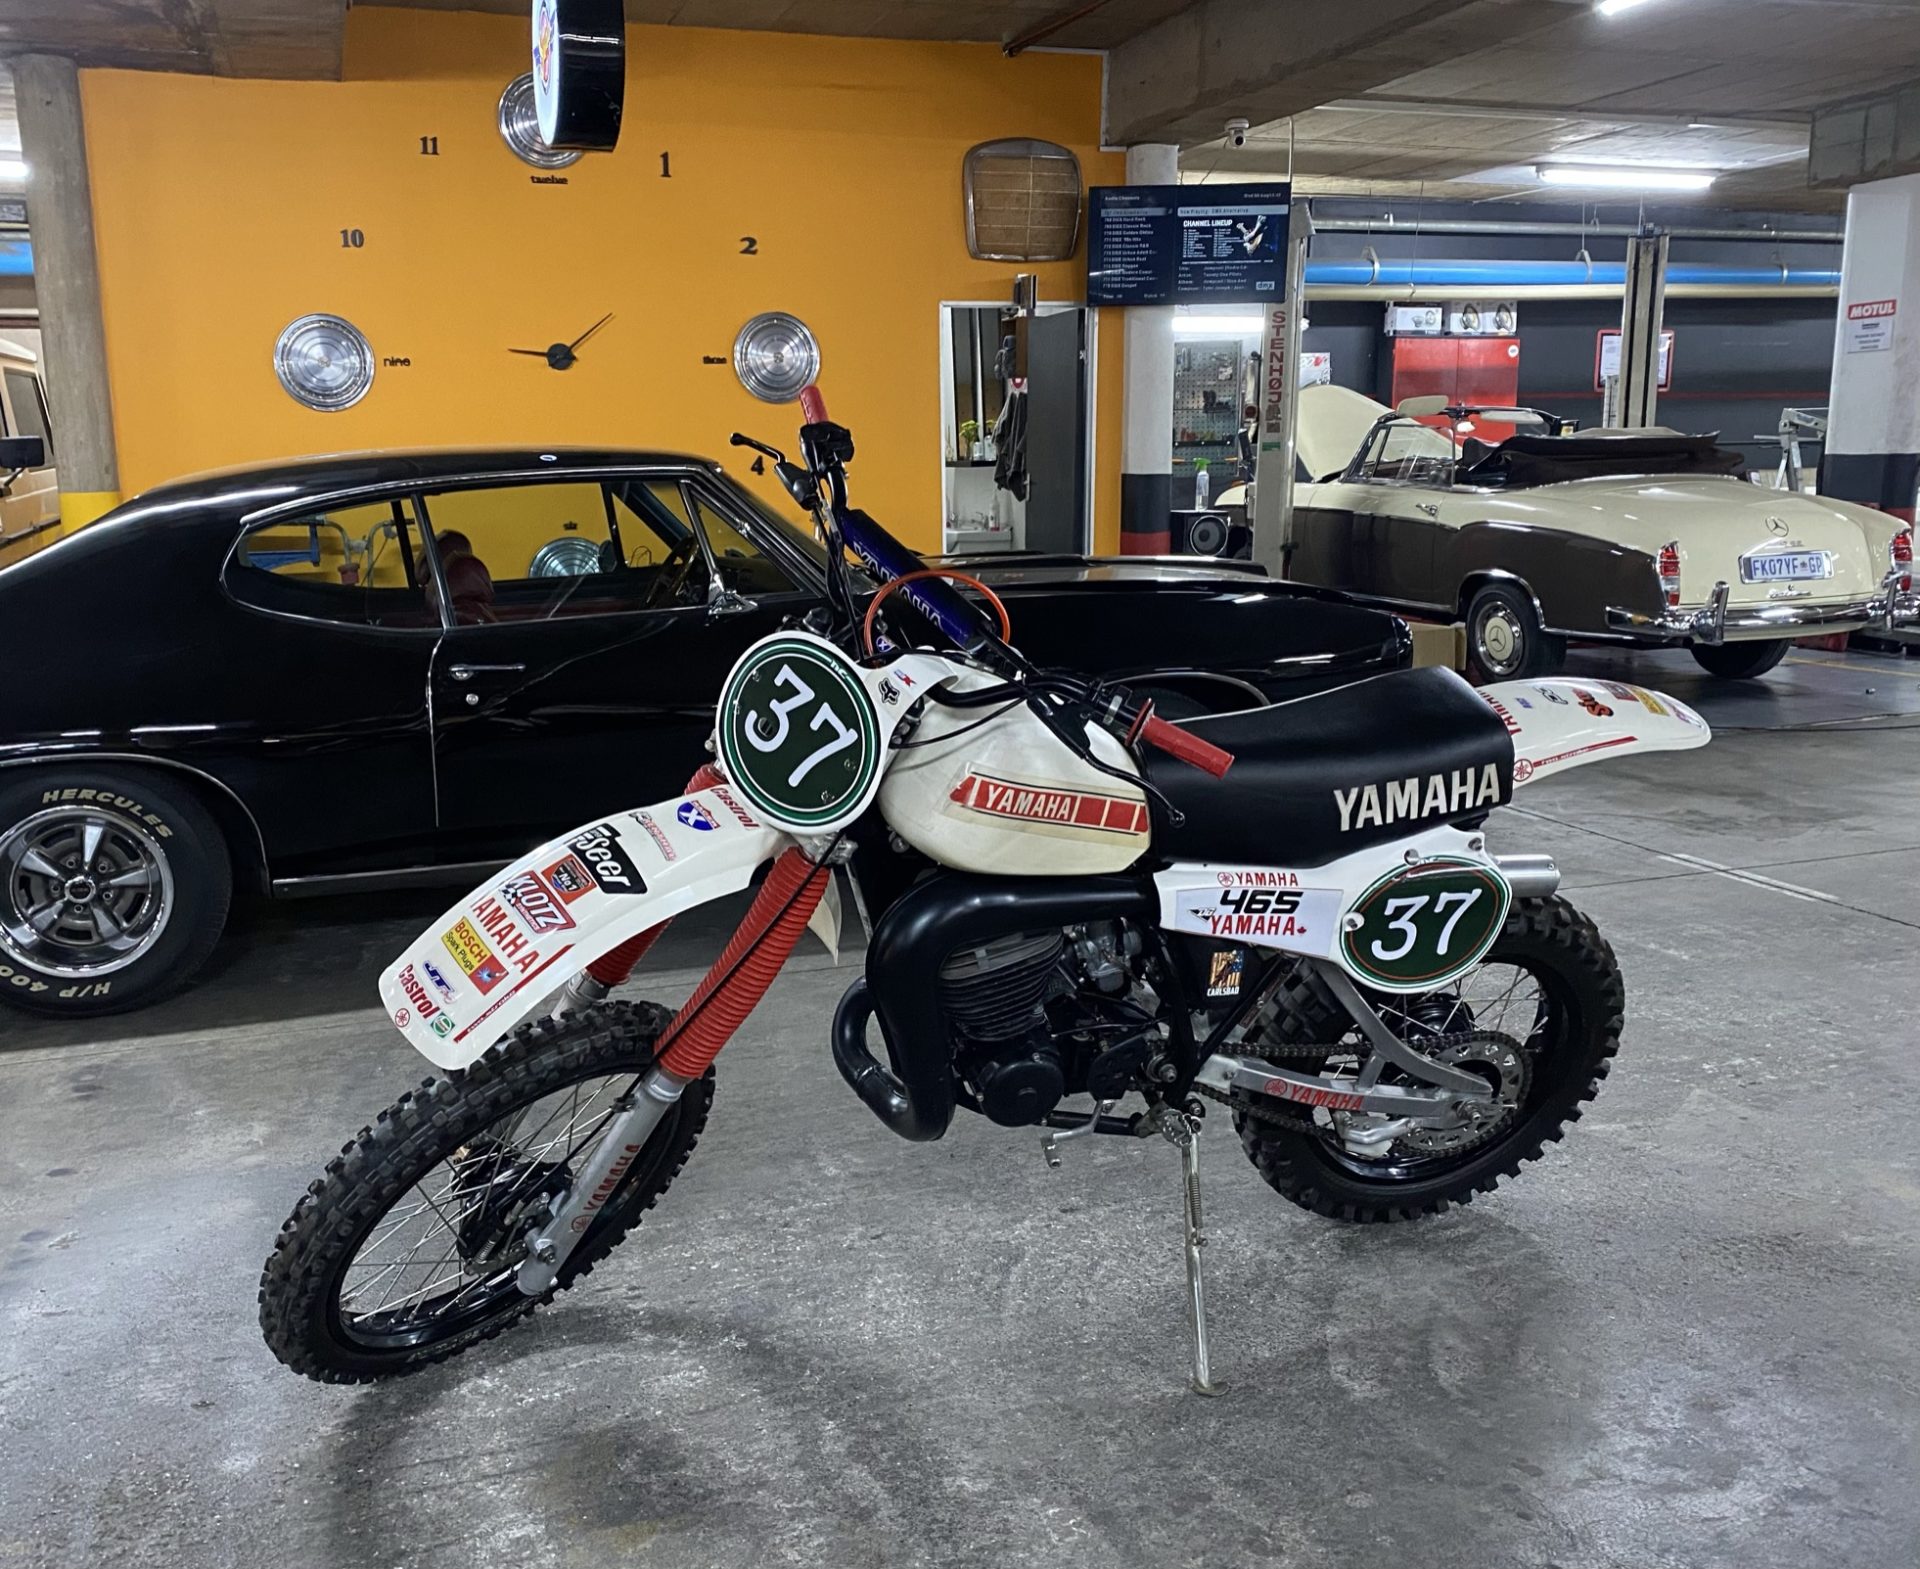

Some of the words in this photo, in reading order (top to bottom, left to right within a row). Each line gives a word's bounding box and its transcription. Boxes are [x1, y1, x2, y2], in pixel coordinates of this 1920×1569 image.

[419, 136, 440, 156] 11
[659, 152, 671, 178] 1
[1183, 220, 1210, 228] CHANNEL
[1212, 218, 1233, 227] LINEUP
[340, 228, 364, 249] 10
[739, 236, 759, 256] 2
[1849, 301, 1895, 319] MOTUL
[383, 356, 411, 368] nine
[750, 455, 765, 475] 4
[1753, 557, 1799, 577] FK07YF
[1808, 556, 1824, 573] GP
[744, 662, 859, 788] 37
[709, 787, 761, 831] Castrol
[986, 782, 1071, 823] YAMAHA
[1334, 763, 1501, 832] YAMAHA
[42, 788, 174, 838] HERCULES
[576, 836, 632, 888] Seer
[1235, 872, 1299, 887] YAMAHA
[510, 874, 569, 927] KLOTZ
[1220, 889, 1304, 914] 465
[470, 897, 540, 974] AMAHA
[1211, 915, 1296, 936] YAMAHA
[1371, 887, 1483, 961] 37
[446, 932, 461, 954] Spark
[458, 949, 475, 971] Plugs
[455, 919, 488, 964] BOSCH
[59, 981, 112, 998] H/P
[399, 963, 440, 1020] Castrol
[1206, 986, 1240, 997] CARLSBAD
[1288, 1083, 1365, 1113] YAMAHA
[583, 1143, 642, 1211] YAMAHA
